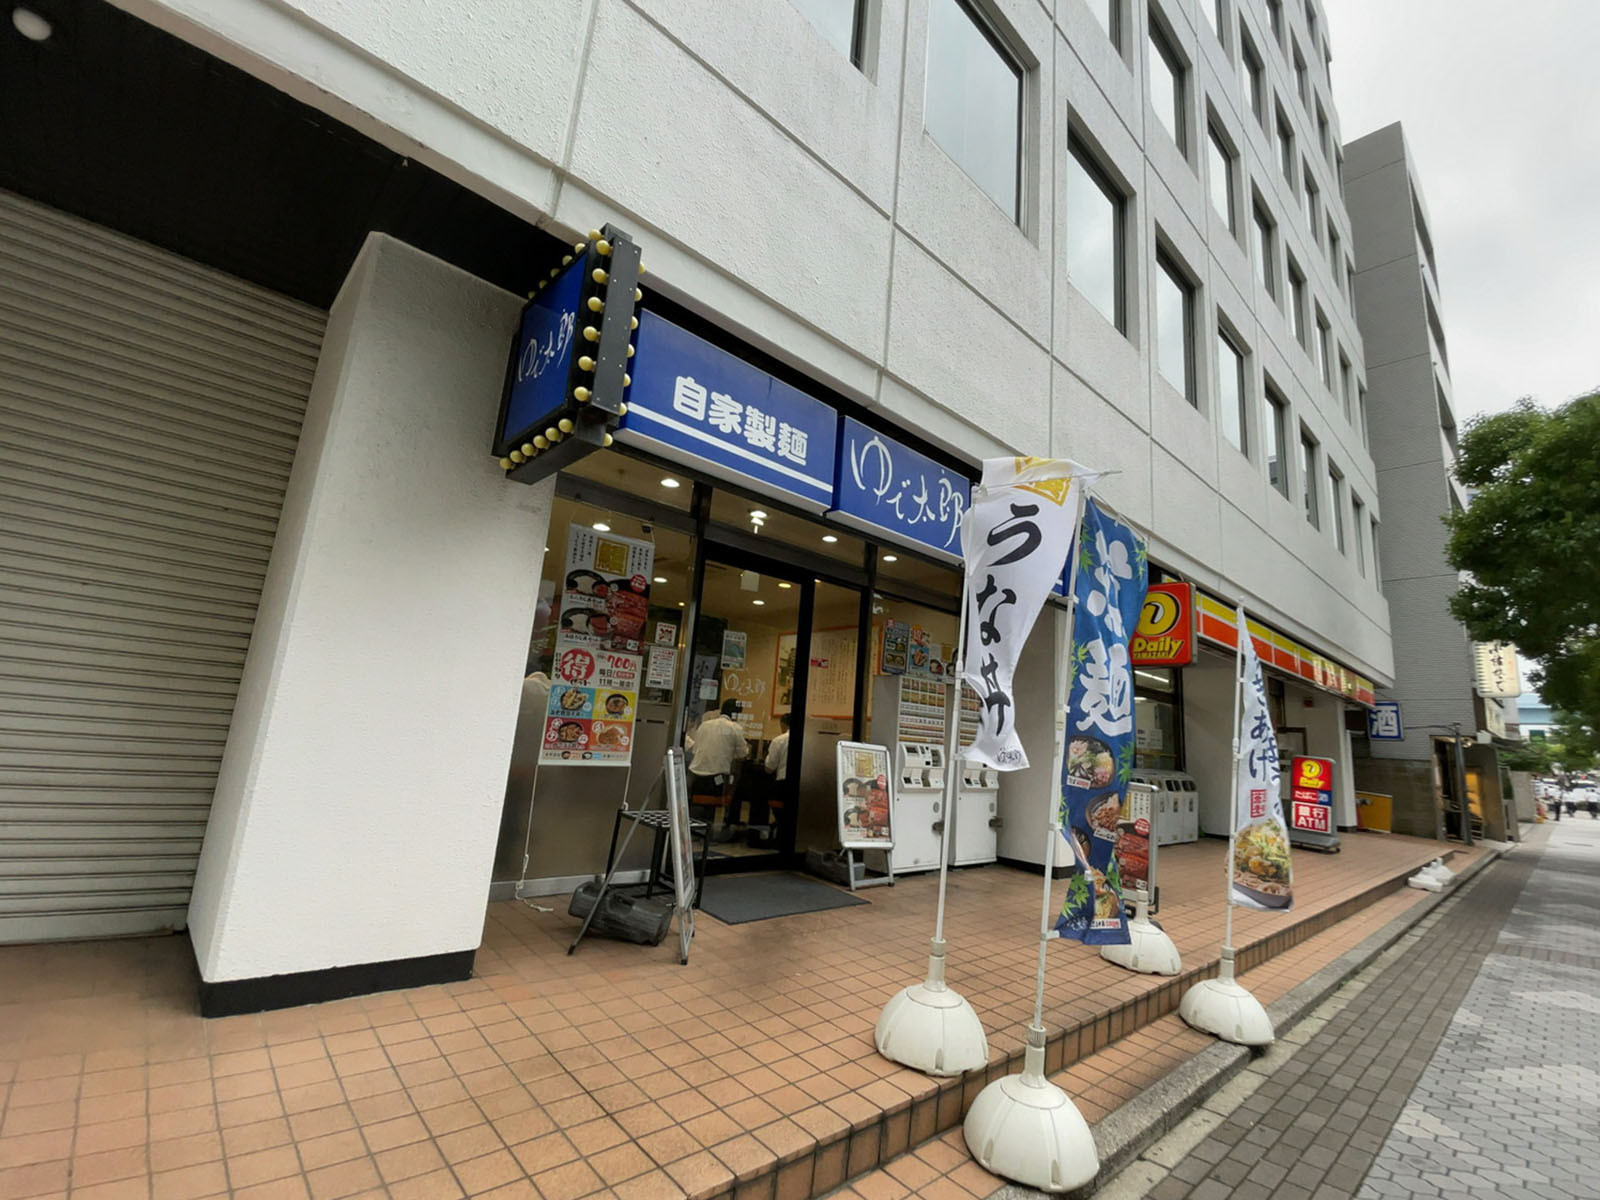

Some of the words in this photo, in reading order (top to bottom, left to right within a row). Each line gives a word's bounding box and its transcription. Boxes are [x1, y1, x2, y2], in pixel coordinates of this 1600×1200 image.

[518, 308, 576, 382] ゆで太郎
[673, 375, 808, 466] 自家製麺
[850, 436, 963, 548] ゆで太郎
[1133, 637, 1184, 659] Daily
[562, 653, 591, 679] 得
[1371, 708, 1399, 737] 酒
[1297, 817, 1326, 830] ATM
[1298, 805, 1325, 819] 銀行
